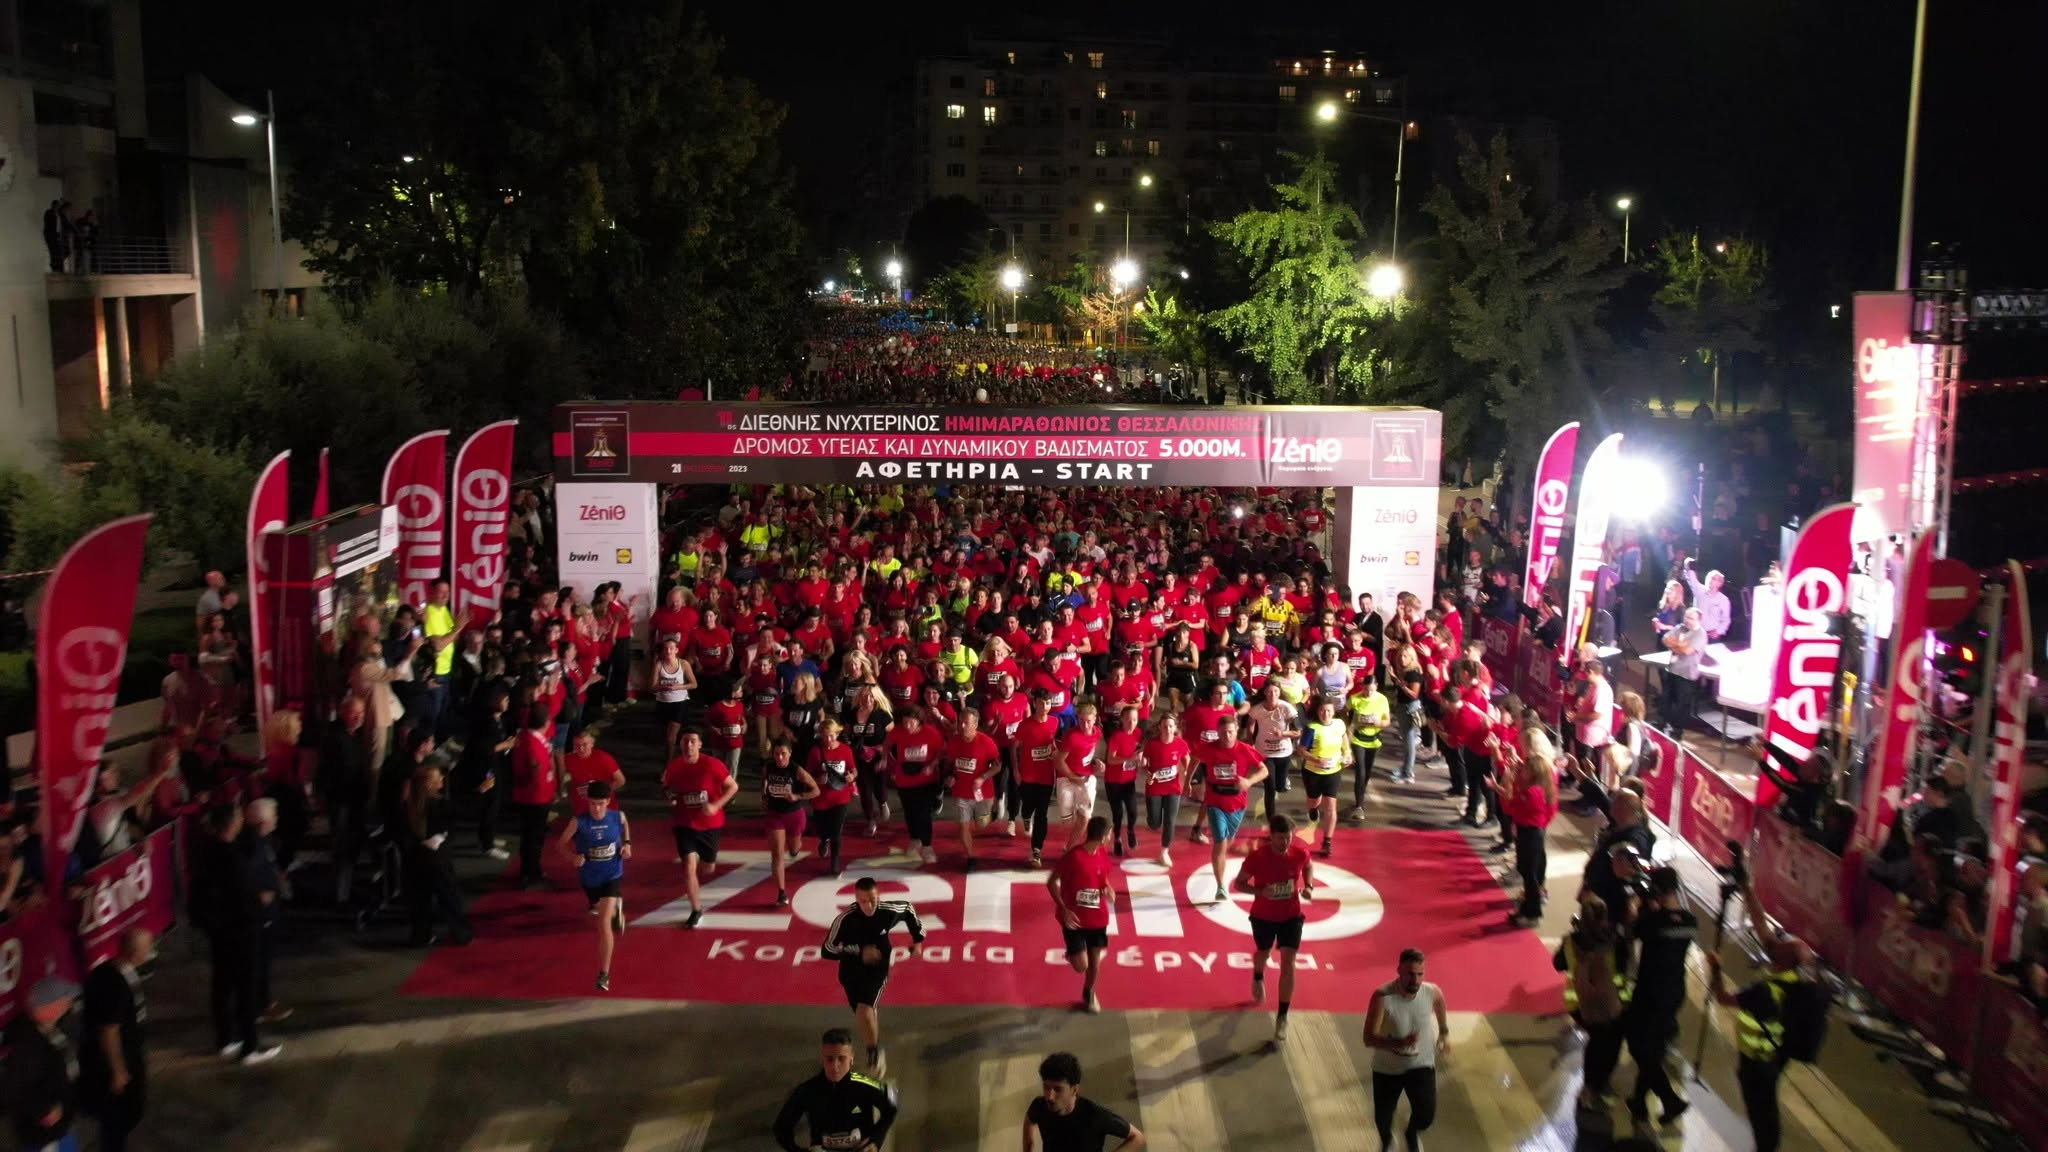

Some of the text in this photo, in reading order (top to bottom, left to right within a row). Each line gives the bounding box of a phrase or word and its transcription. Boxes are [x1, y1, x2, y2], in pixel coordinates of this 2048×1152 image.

[740, 414, 821, 431] ΔΙΕΘΝΗΣ
[826, 414, 940, 431] ΝΥΧΤΕΡΙΝΟΣ
[945, 415, 1111, 432] ΗΜΙΜΑΡΑΘΩΝΙΟΣ
[733, 437, 812, 455] ΔΡΟΜΟΣ
[818, 438, 879, 455] ΥΓΕΙΑΣ
[885, 438, 914, 455] ΚΑΙ
[920, 439, 1029, 456] ΔΥΝΑΜΙΚΟΥ
[1035, 439, 1148, 457] ΒΑΔΙΣΜΑΤΟΣ
[728, 465, 748, 473] 2023
[856, 461, 1019, 479] ΑΦΕΤΗΡΙΑ
[1056, 462, 1153, 480] START
[568, 551, 599, 562] bwin
[1359, 553, 1388, 563] bwin
[707, 939, 1335, 973] Κοραία εέργεια.
